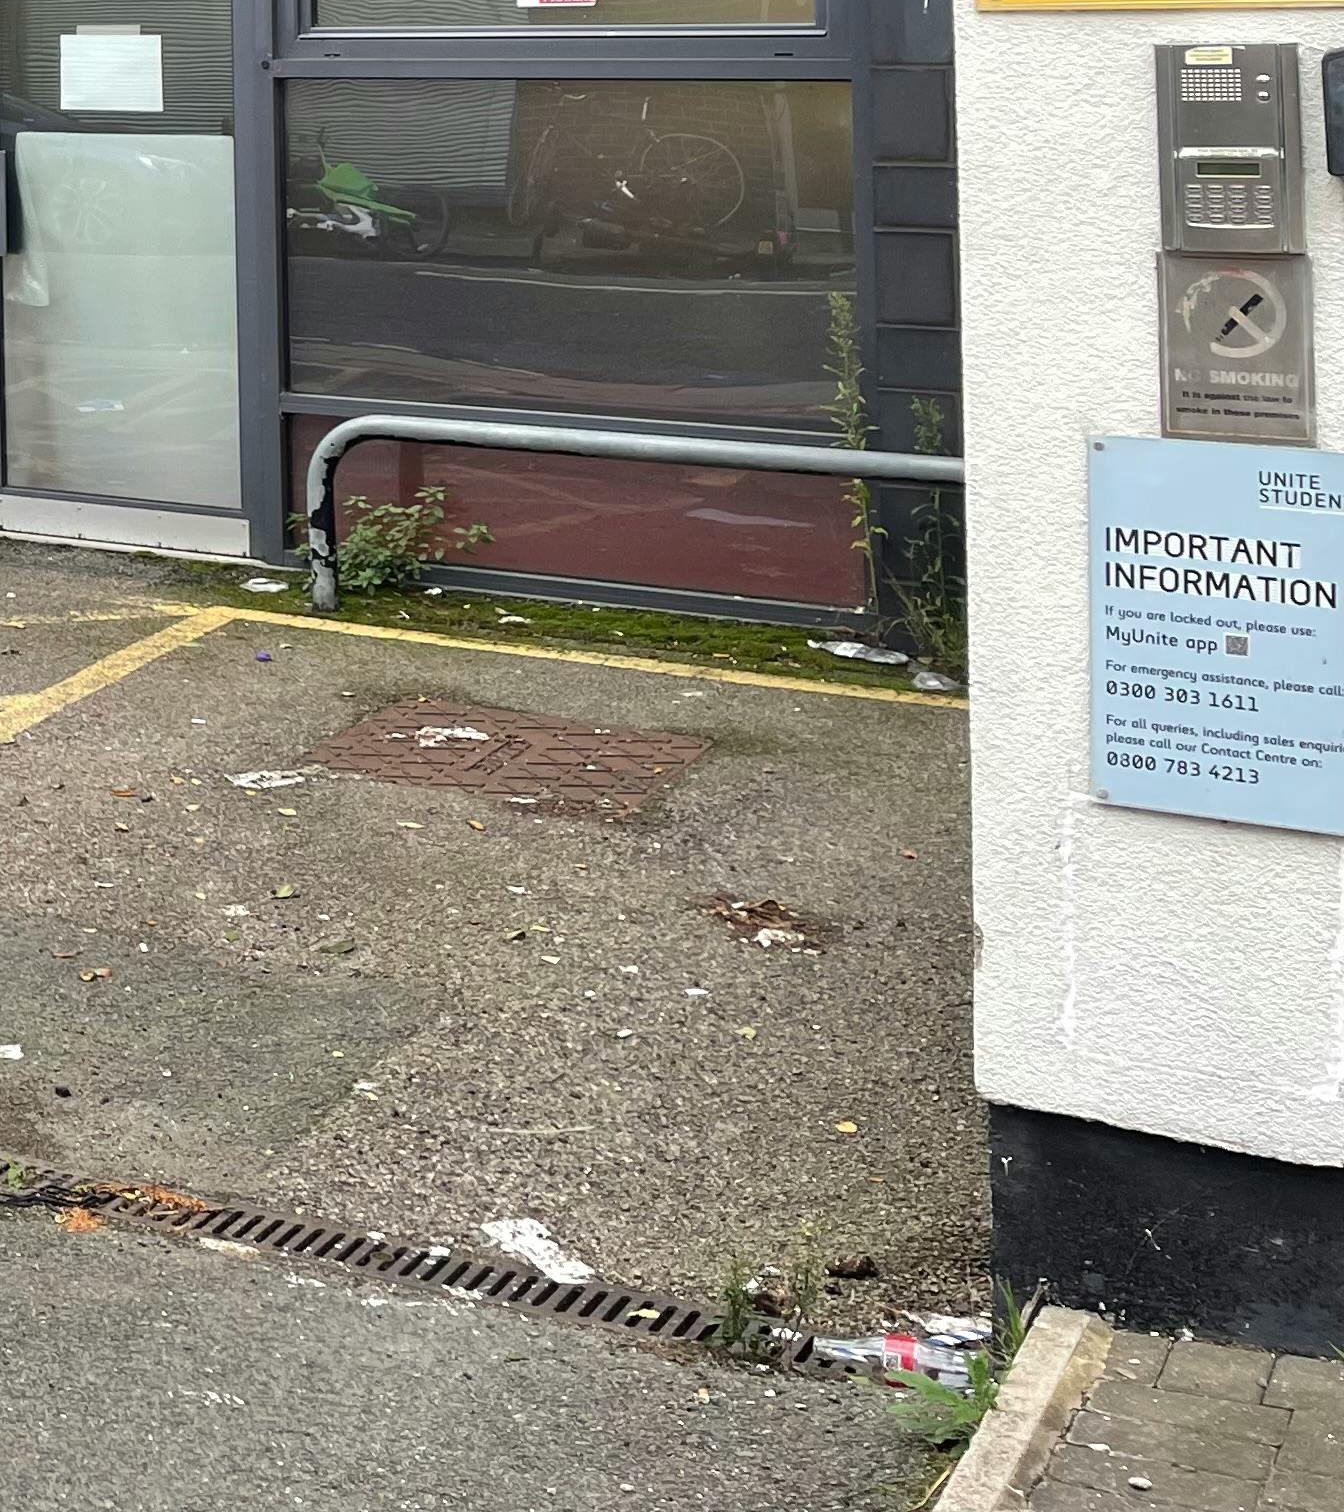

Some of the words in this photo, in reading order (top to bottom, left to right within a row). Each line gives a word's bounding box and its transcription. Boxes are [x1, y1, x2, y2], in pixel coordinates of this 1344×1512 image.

[1209, 370, 1299, 387] SMOKING
[1259, 471, 1321, 490] UNITE
[1259, 488, 1344, 509] STUDEN
[1105, 526, 1301, 568] IMPORTANT
[1105, 561, 1337, 609] INFORMATION
[1105, 605, 1113, 616] If
[1118, 608, 1142, 620] you
[1146, 611, 1166, 622] are
[1171, 611, 1211, 626] locked
[1216, 619, 1242, 631] out,
[1246, 620, 1287, 634] please
[1106, 625, 1178, 647] MyUnite
[1186, 638, 1218, 655] app
[1106, 659, 1127, 672] For
[1131, 664, 1197, 683] emergency
[1201, 673, 1269, 690] assistance,
[1273, 679, 1314, 693] please
[1106, 680, 1156, 700] 0300
[1164, 686, 1200, 705] 303
[1208, 691, 1259, 712] 1611
[1106, 714, 1127, 727] For
[1131, 718, 1147, 730] all
[1151, 723, 1199, 737] queries,
[1202, 726, 1259, 747] including
[1263, 735, 1295, 748] sales
[1299, 740, 1344, 754] enquiri
[1106, 732, 1145, 746] please
[1149, 738, 1172, 750] call
[1175, 743, 1197, 753] our
[1201, 742, 1252, 760] Contact
[1255, 749, 1297, 766] Centre
[1107, 751, 1156, 771] 0800
[1163, 758, 1201, 777] 783
[1208, 764, 1259, 784] 4213
